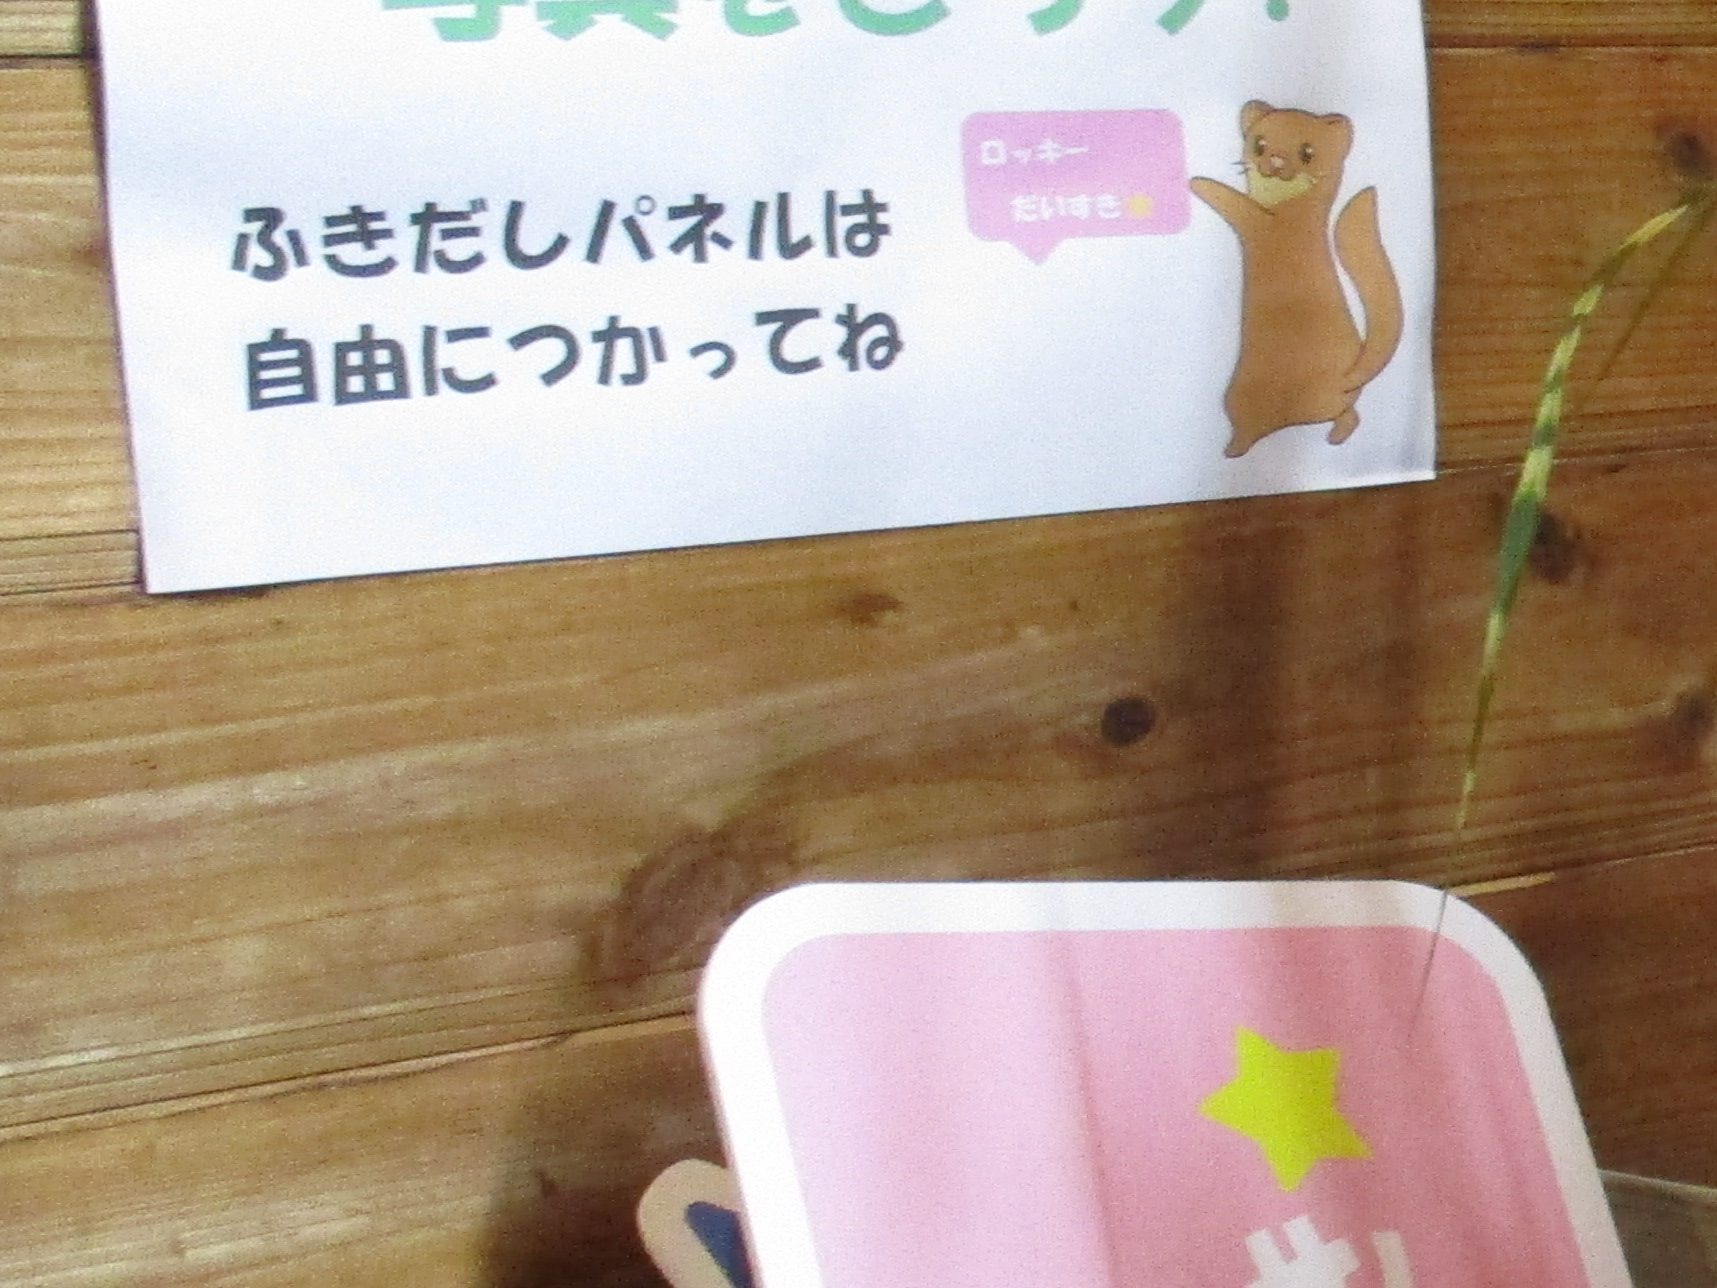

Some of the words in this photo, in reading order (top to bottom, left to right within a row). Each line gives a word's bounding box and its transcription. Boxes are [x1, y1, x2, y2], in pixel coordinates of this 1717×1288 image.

[979, 139, 1090, 166] ロッキー
[231, 186, 893, 280] ふきだしパネルは
[1011, 194, 1122, 222] だいすき
[244, 303, 902, 412] 自由につかってね
